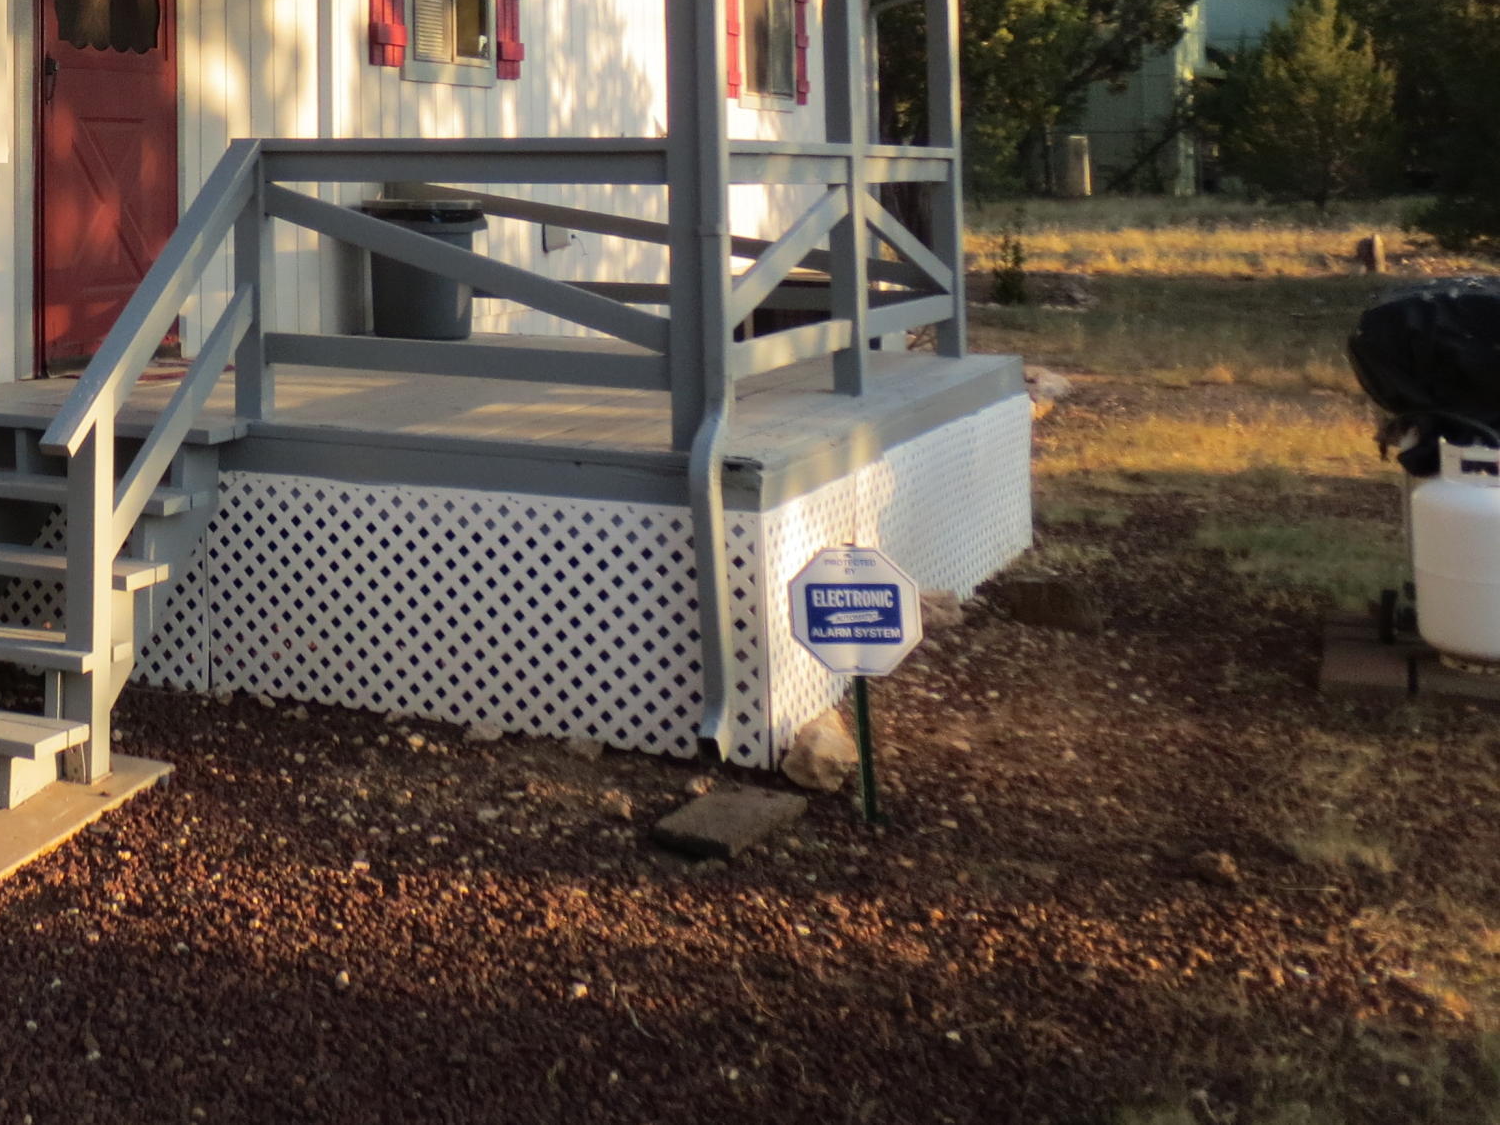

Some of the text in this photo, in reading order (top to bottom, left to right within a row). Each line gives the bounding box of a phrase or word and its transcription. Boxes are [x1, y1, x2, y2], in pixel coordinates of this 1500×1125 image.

[824, 559, 877, 567] PROTECTED
[845, 568, 855, 576] BY
[811, 588, 894, 609] ELECTRONIC
[811, 627, 901, 639] ALARM SYSTEM
